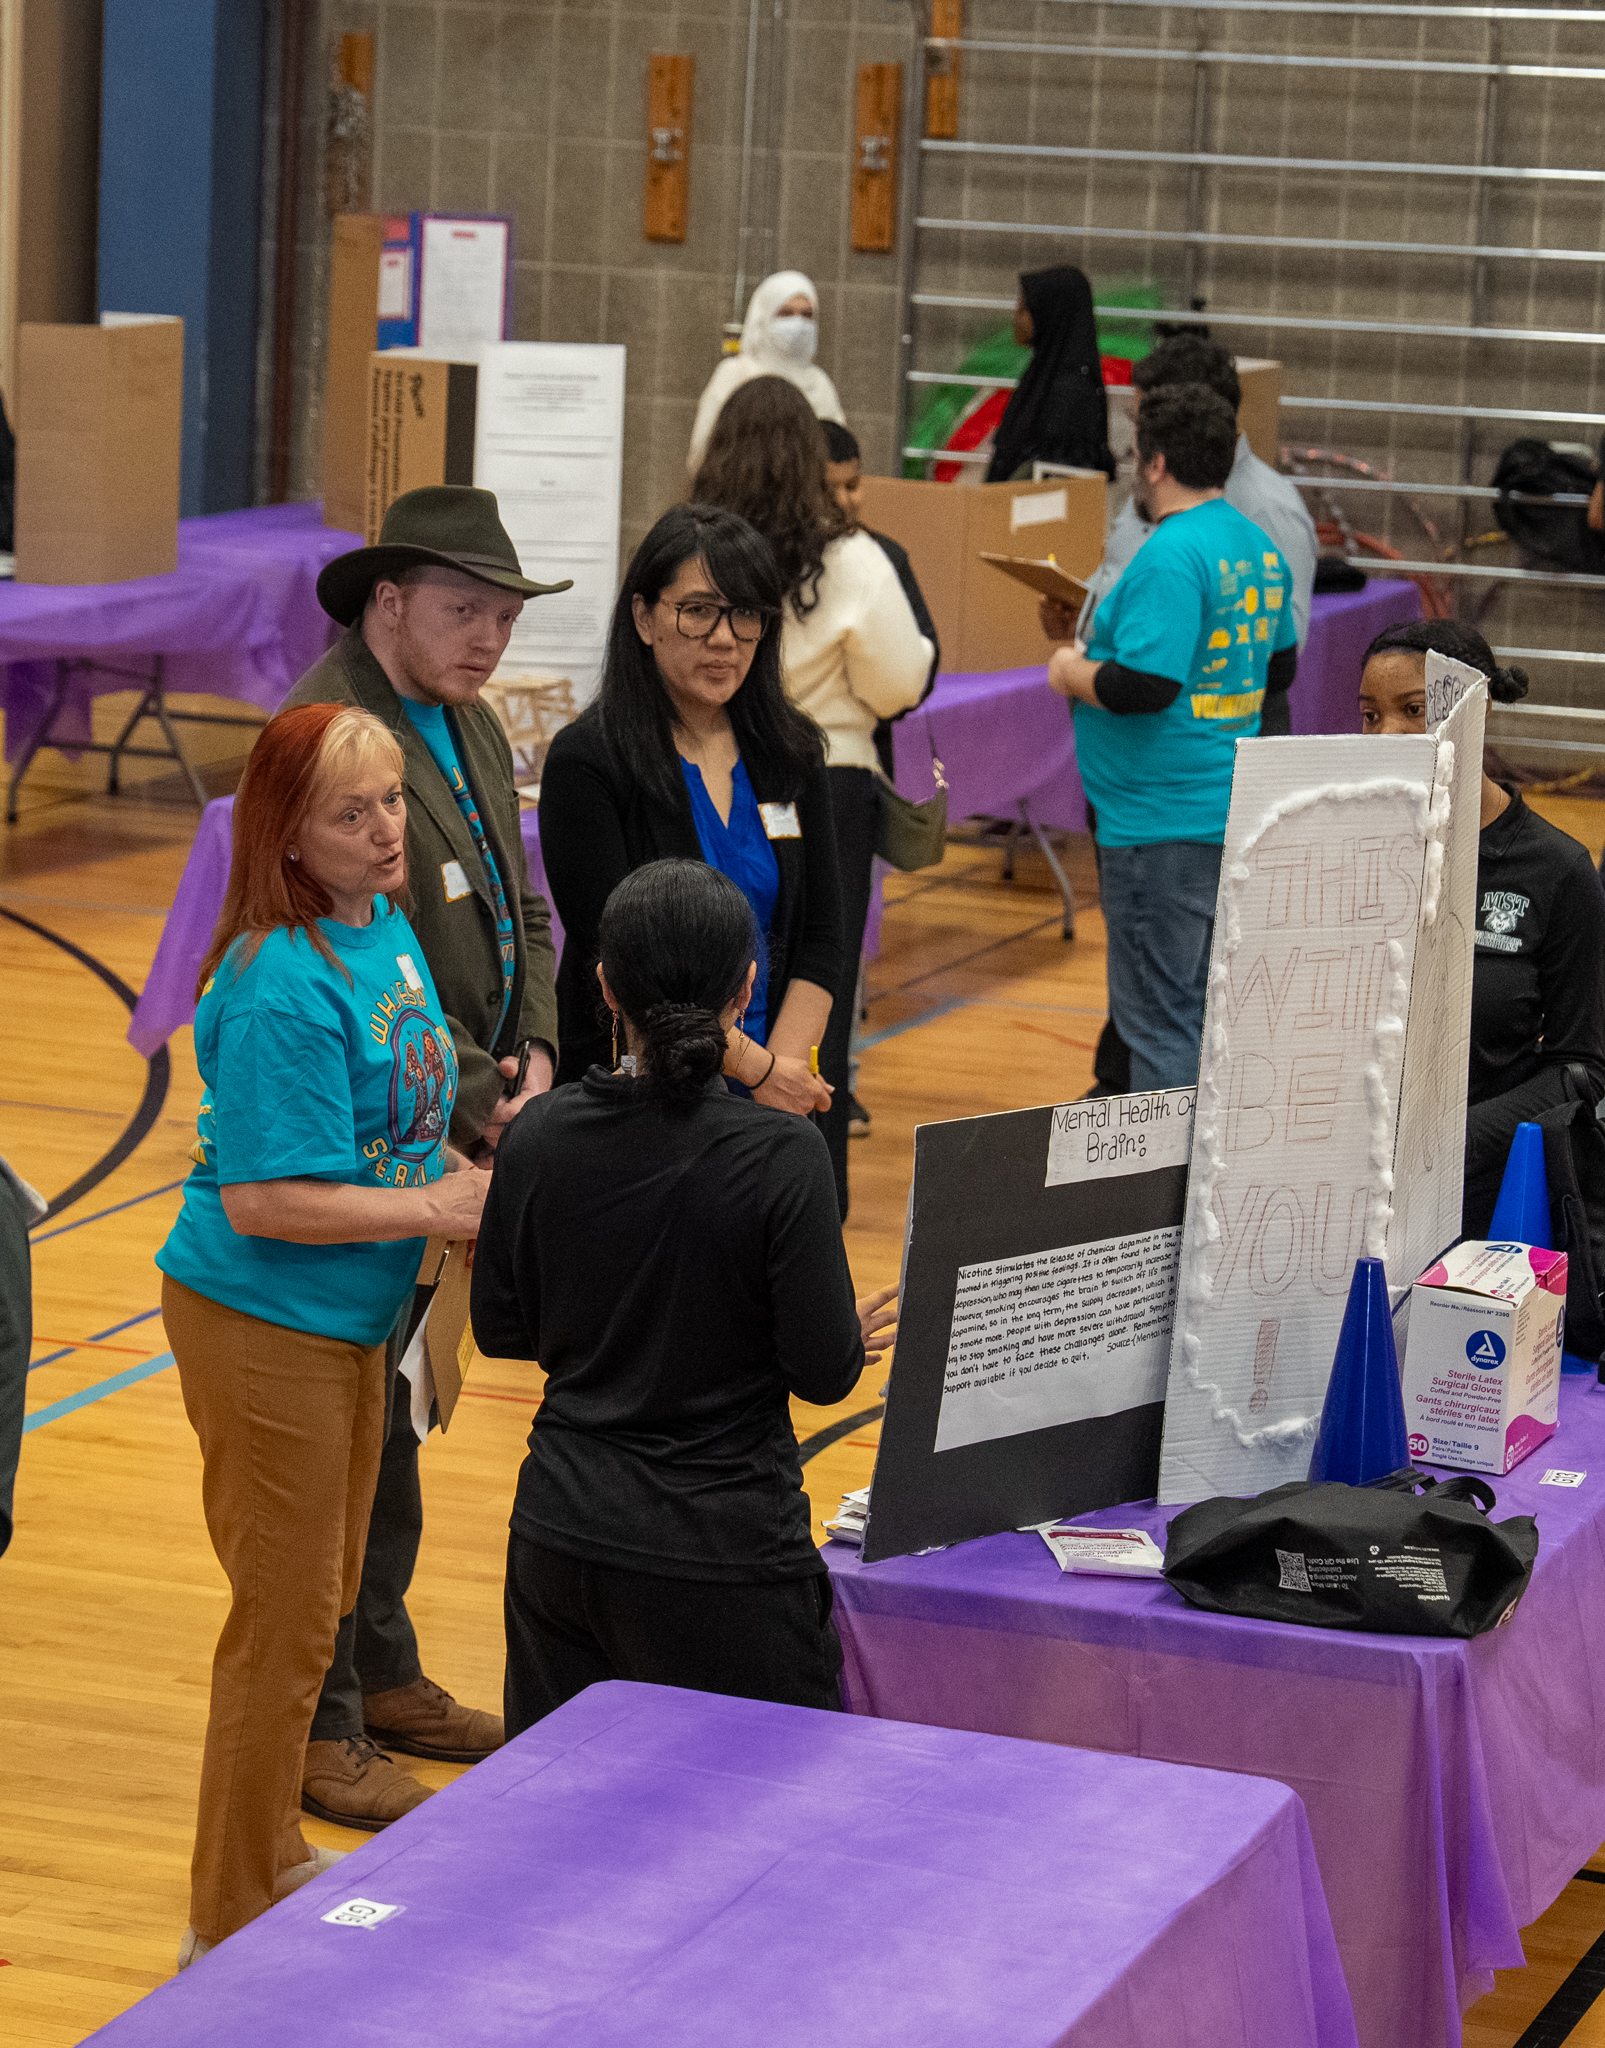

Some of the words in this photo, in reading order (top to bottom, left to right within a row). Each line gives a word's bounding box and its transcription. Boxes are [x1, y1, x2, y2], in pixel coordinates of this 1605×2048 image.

[1256, 833, 1419, 938] THIS
[1481, 892, 1530, 917] MST
[1052, 1102, 1110, 1135] Mental
[1119, 1096, 1170, 1127] Health
[1224, 1053, 1343, 1153] BE
[959, 1268, 993, 1279] Nicotine
[1077, 1249, 1085, 1258] of
[1119, 1236, 1151, 1250] dopamine
[1209, 1183, 1370, 1310] YOU
[991, 1275, 1023, 1288] triggering
[1026, 1270, 1049, 1281] positive
[1082, 1259, 1091, 1268] It
[1094, 1258, 1099, 1266] is
[1102, 1256, 1117, 1265] often
[1121, 1249, 1139, 1259] found
[1009, 1289, 1022, 1299] may
[1025, 1285, 1039, 1293] then
[1042, 1281, 1054, 1289] use
[1106, 1261, 1142, 1276] temporarily
[1146, 1253, 1171, 1264] increase
[951, 1323, 987, 1338] dopamine,
[990, 1319, 997, 1327] so
[1011, 1315, 1023, 1323] the
[1027, 1311, 1040, 1320] long
[1043, 1308, 1064, 1316] term,
[1066, 1302, 1078, 1310] the
[1146, 1278, 1165, 1289] which
[953, 1312, 983, 1323] However,
[985, 1302, 1016, 1316] smoking
[1018, 1292, 1059, 1308] encourages
[1079, 1285, 1098, 1294] brain
[1102, 1280, 1108, 1288] to
[1111, 1275, 1133, 1286] switch
[1136, 1270, 1145, 1279] off
[948, 1357, 958, 1366] try
[960, 1354, 967, 1362] to
[1022, 1337, 1034, 1346] and
[1038, 1334, 1054, 1342] have
[1058, 1328, 1076, 1339] more
[1080, 1322, 1103, 1333] severe
[1107, 1309, 1145, 1326] withdrawal
[960, 1338, 982, 1349] smoke
[985, 1335, 1004, 1343] more.
[1034, 1322, 1051, 1330] with
[1054, 1312, 1096, 1328] depression
[1099, 1308, 1112, 1317] can
[1115, 1302, 1130, 1311] have
[1133, 1290, 1165, 1308] particular
[961, 1364, 979, 1375] don't
[983, 1361, 998, 1371] have
[1003, 1356, 1011, 1365] to
[1016, 1351, 1034, 1362] face
[1040, 1346, 1061, 1356] these
[1109, 1327, 1128, 1337] alone.
[974, 1373, 1005, 1387] available
[1010, 1368, 1015, 1377] if
[1034, 1360, 1058, 1371] decide
[1062, 1357, 1068, 1365] to
[1071, 1352, 1089, 1363] quit.
[1471, 1355, 1498, 1365] dynarex
[1430, 1387, 1450, 1395] Cuffed
[1464, 1392, 1501, 1403] Powder-Free
[1432, 1377, 1469, 1389] Surgical
[1471, 1384, 1502, 1395] Gloves
[1448, 1370, 1476, 1381] Sterile
[1478, 1375, 1503, 1385] Latex
[1416, 1394, 1442, 1405] Gants
[1445, 1400, 1500, 1415] chirurgicaux
[1430, 1407, 1462, 1418] stériles
[1478, 1414, 1499, 1424] latex
[1409, 1438, 1427, 1452] 50
[1433, 1438, 1472, 1449] Size/Taille
[1477, 1425, 1499, 1433] poudré
[1552, 1472, 1578, 1483] G13
